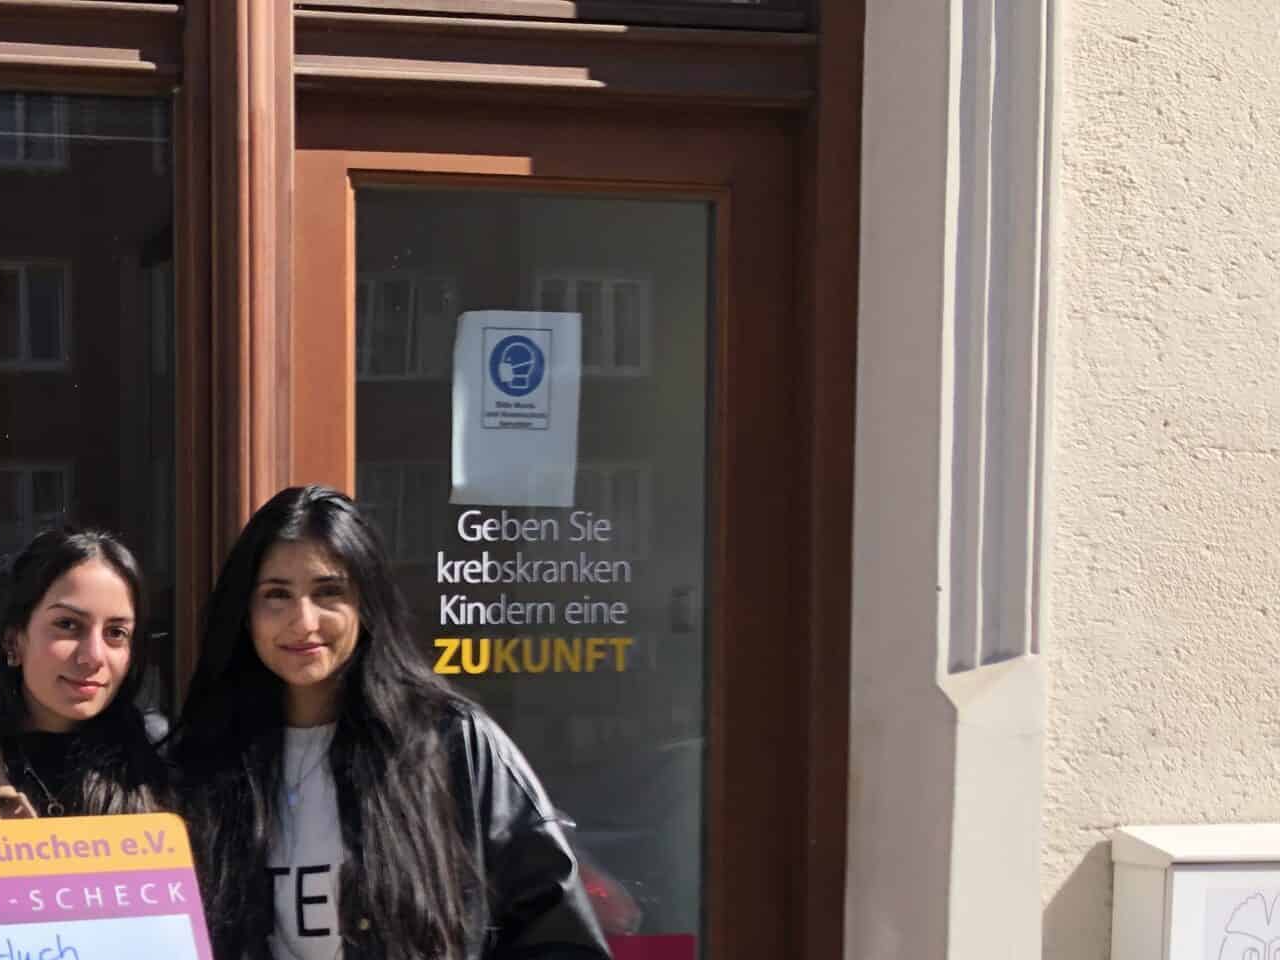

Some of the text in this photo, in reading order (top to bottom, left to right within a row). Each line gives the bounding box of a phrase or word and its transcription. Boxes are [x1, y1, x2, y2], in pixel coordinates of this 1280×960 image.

[457, 510, 611, 543] Geben Sie
[437, 551, 632, 584] krebskranken
[439, 593, 628, 625] Kindern eine
[433, 637, 633, 675] ZUKUNFT
[120, 830, 176, 856] e.V.
